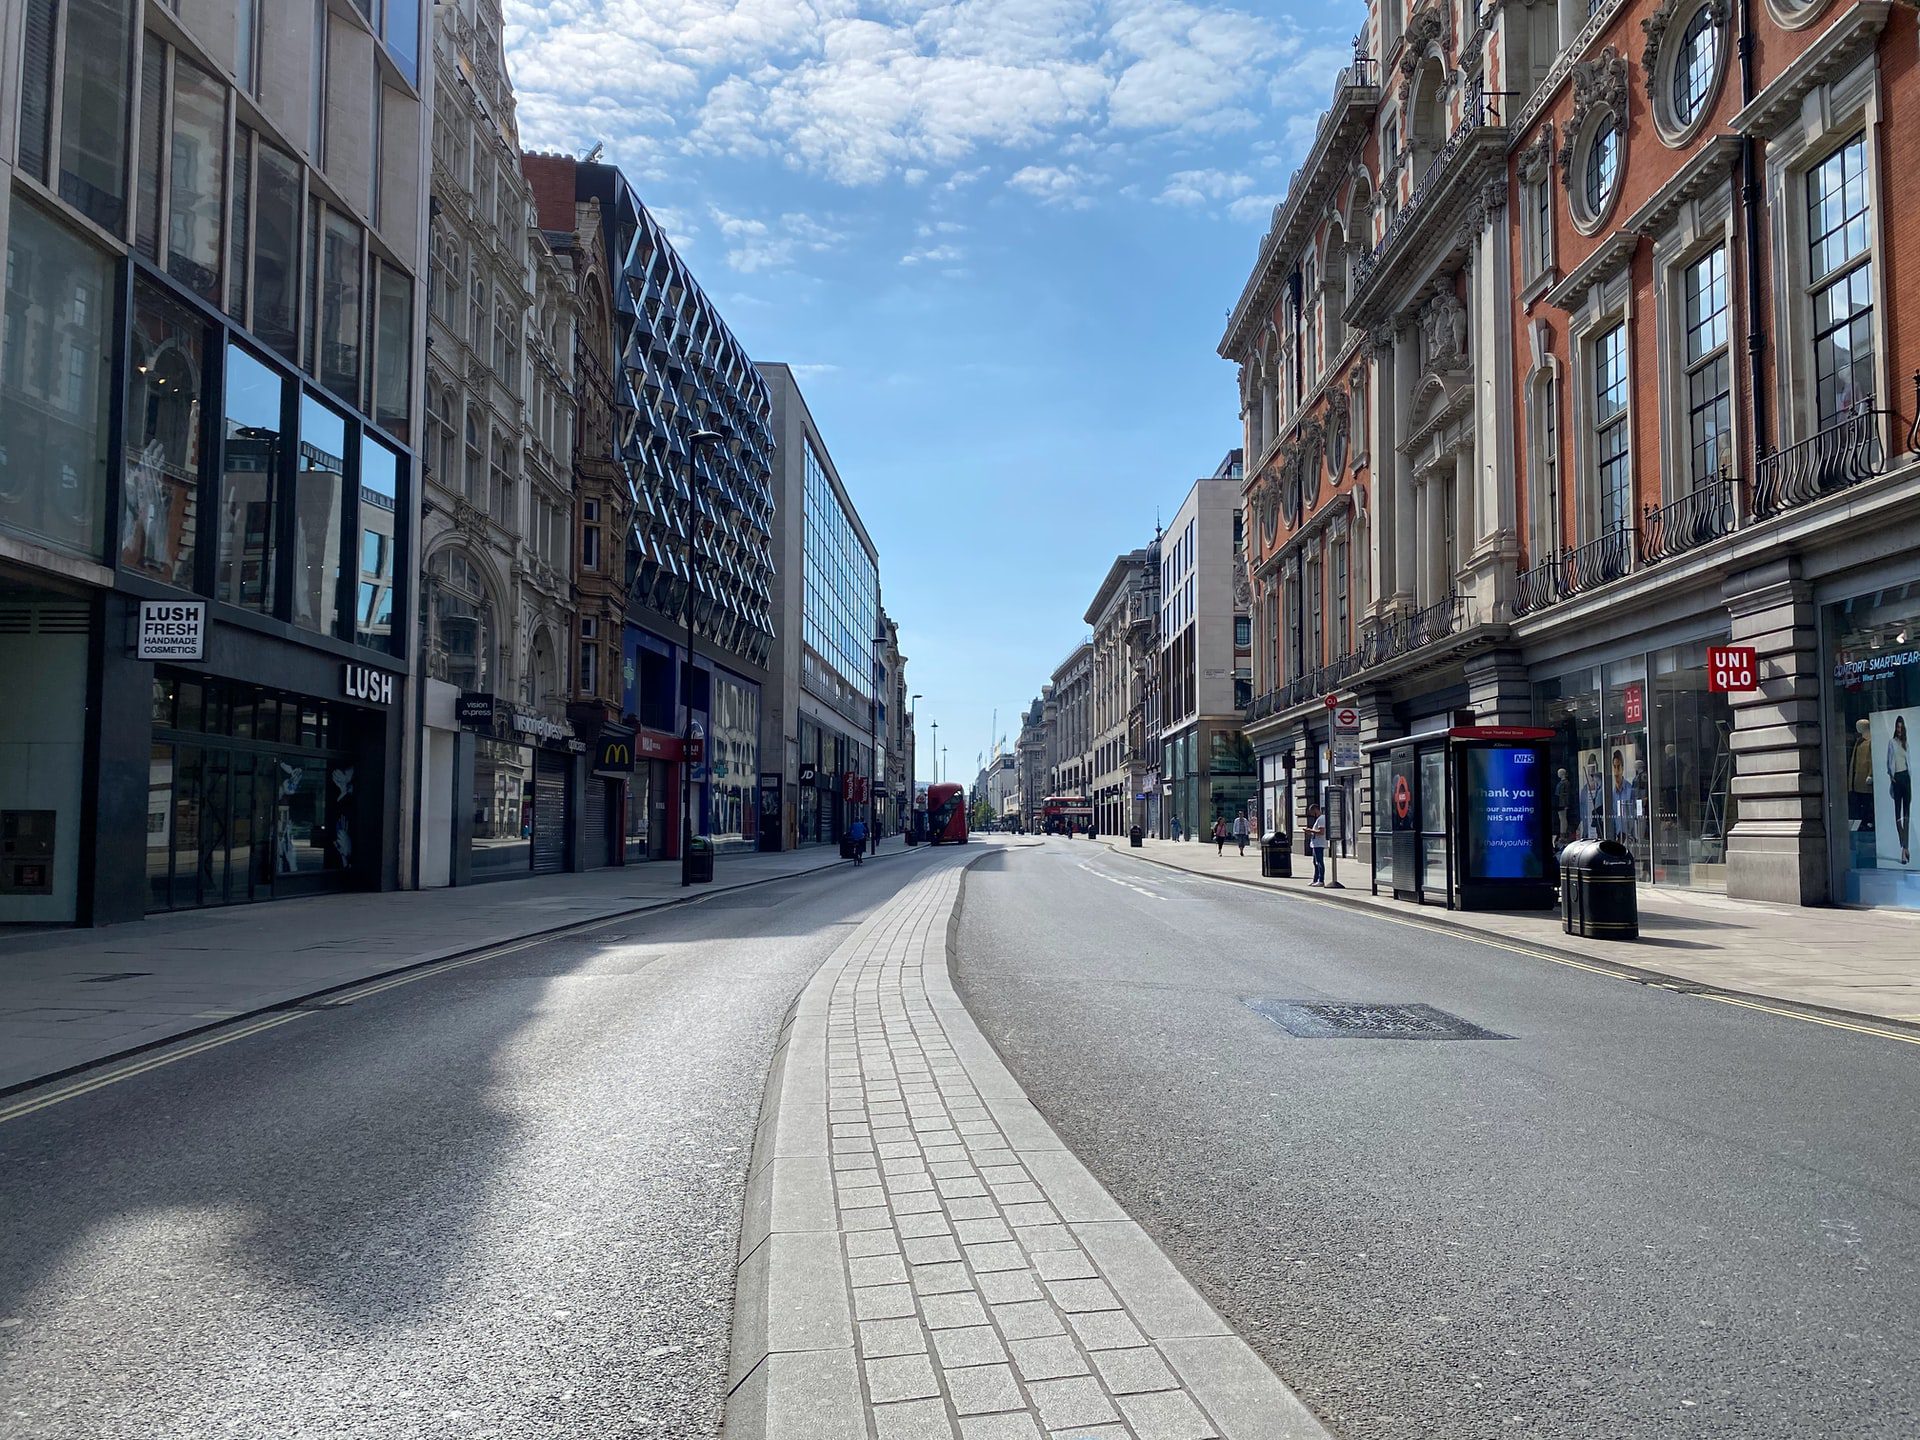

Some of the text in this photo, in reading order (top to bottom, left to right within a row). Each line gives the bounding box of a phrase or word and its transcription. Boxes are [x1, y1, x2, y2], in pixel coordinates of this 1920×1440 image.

[145, 607, 199, 621] LUSH
[145, 623, 198, 636] FRESH
[144, 637, 197, 645] HANDMADE
[144, 646, 197, 654] COSMETICS
[1715, 652, 1748, 668] UNI
[1833, 650, 1920, 677] COMFORT SMARTWEAR
[1716, 670, 1751, 688] QLO
[346, 664, 393, 704] LUSH
[466, 701, 488, 709] vision
[462, 709, 492, 717] express
[1514, 754, 1534, 763] NHS
[801, 770, 814, 779] JD
[1512, 790, 1534, 800] you
[1501, 805, 1535, 814] amazing
